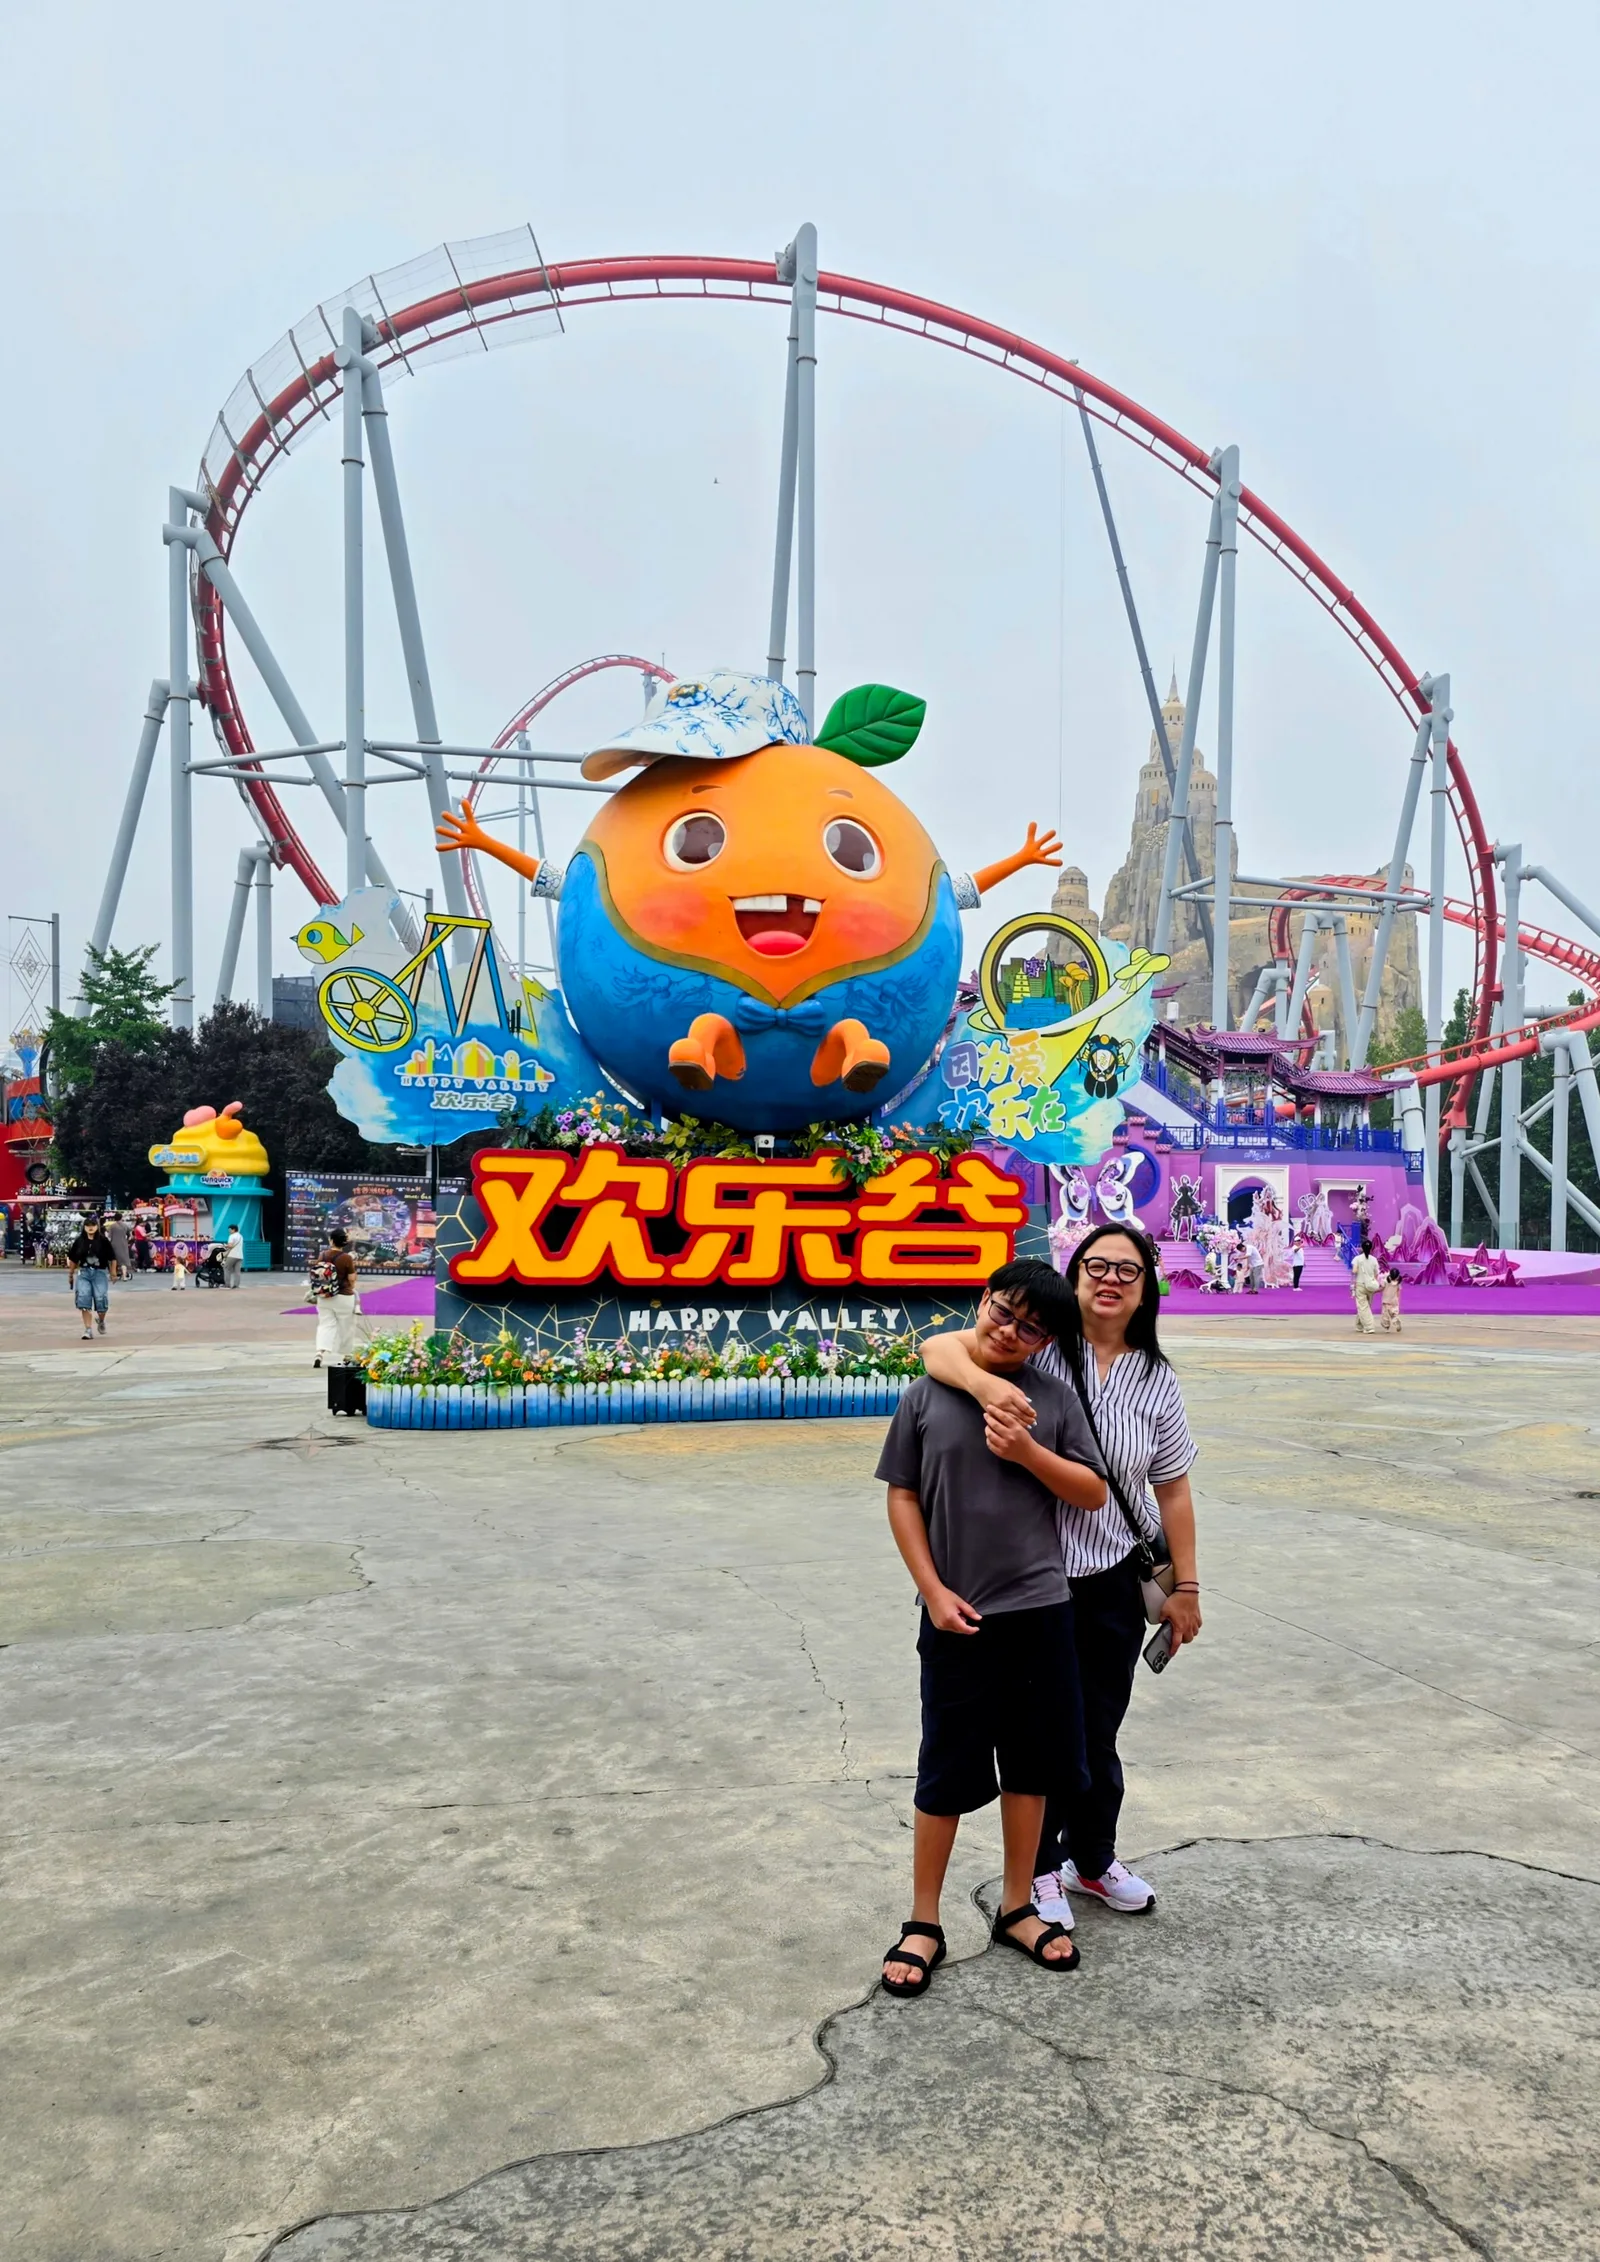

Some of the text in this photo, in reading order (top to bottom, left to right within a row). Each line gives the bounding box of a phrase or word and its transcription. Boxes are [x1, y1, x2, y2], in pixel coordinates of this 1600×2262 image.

[942, 1029, 1046, 1089] 因为爱
[400, 1076, 549, 1092] HAPPY VALLEY
[430, 1090, 516, 1111] 欢乐谷
[938, 1085, 1067, 1140] 欢乐在
[455, 1149, 1025, 1281] 欢乐谷
[628, 1307, 901, 1331] HAPPY VALLEY
